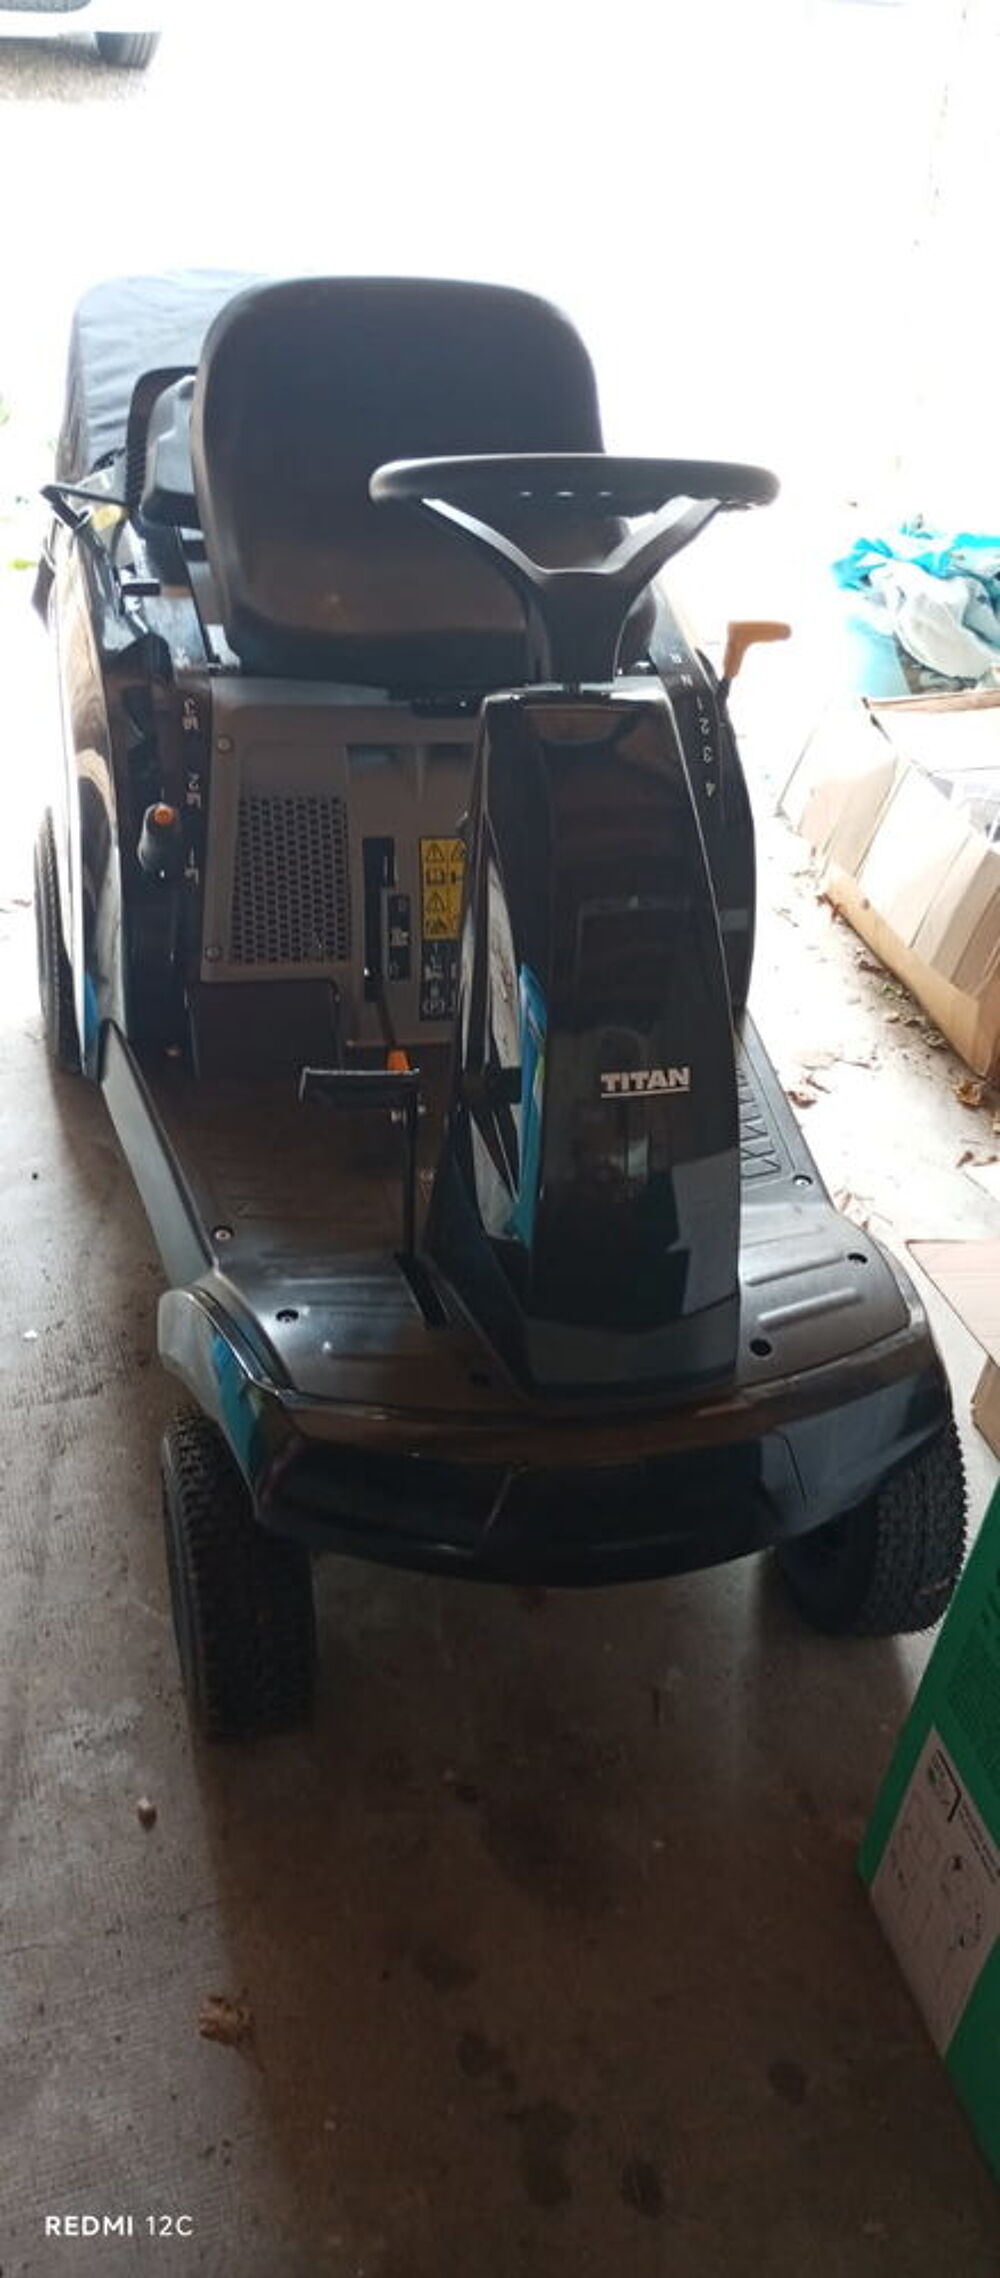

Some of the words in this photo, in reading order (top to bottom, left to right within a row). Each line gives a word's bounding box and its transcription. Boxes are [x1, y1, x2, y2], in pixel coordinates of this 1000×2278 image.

[699, 717, 710, 735] 2
[703, 746, 712, 764] 3
[705, 780, 716, 798] 4
[600, 1066, 690, 1093] TITAN
